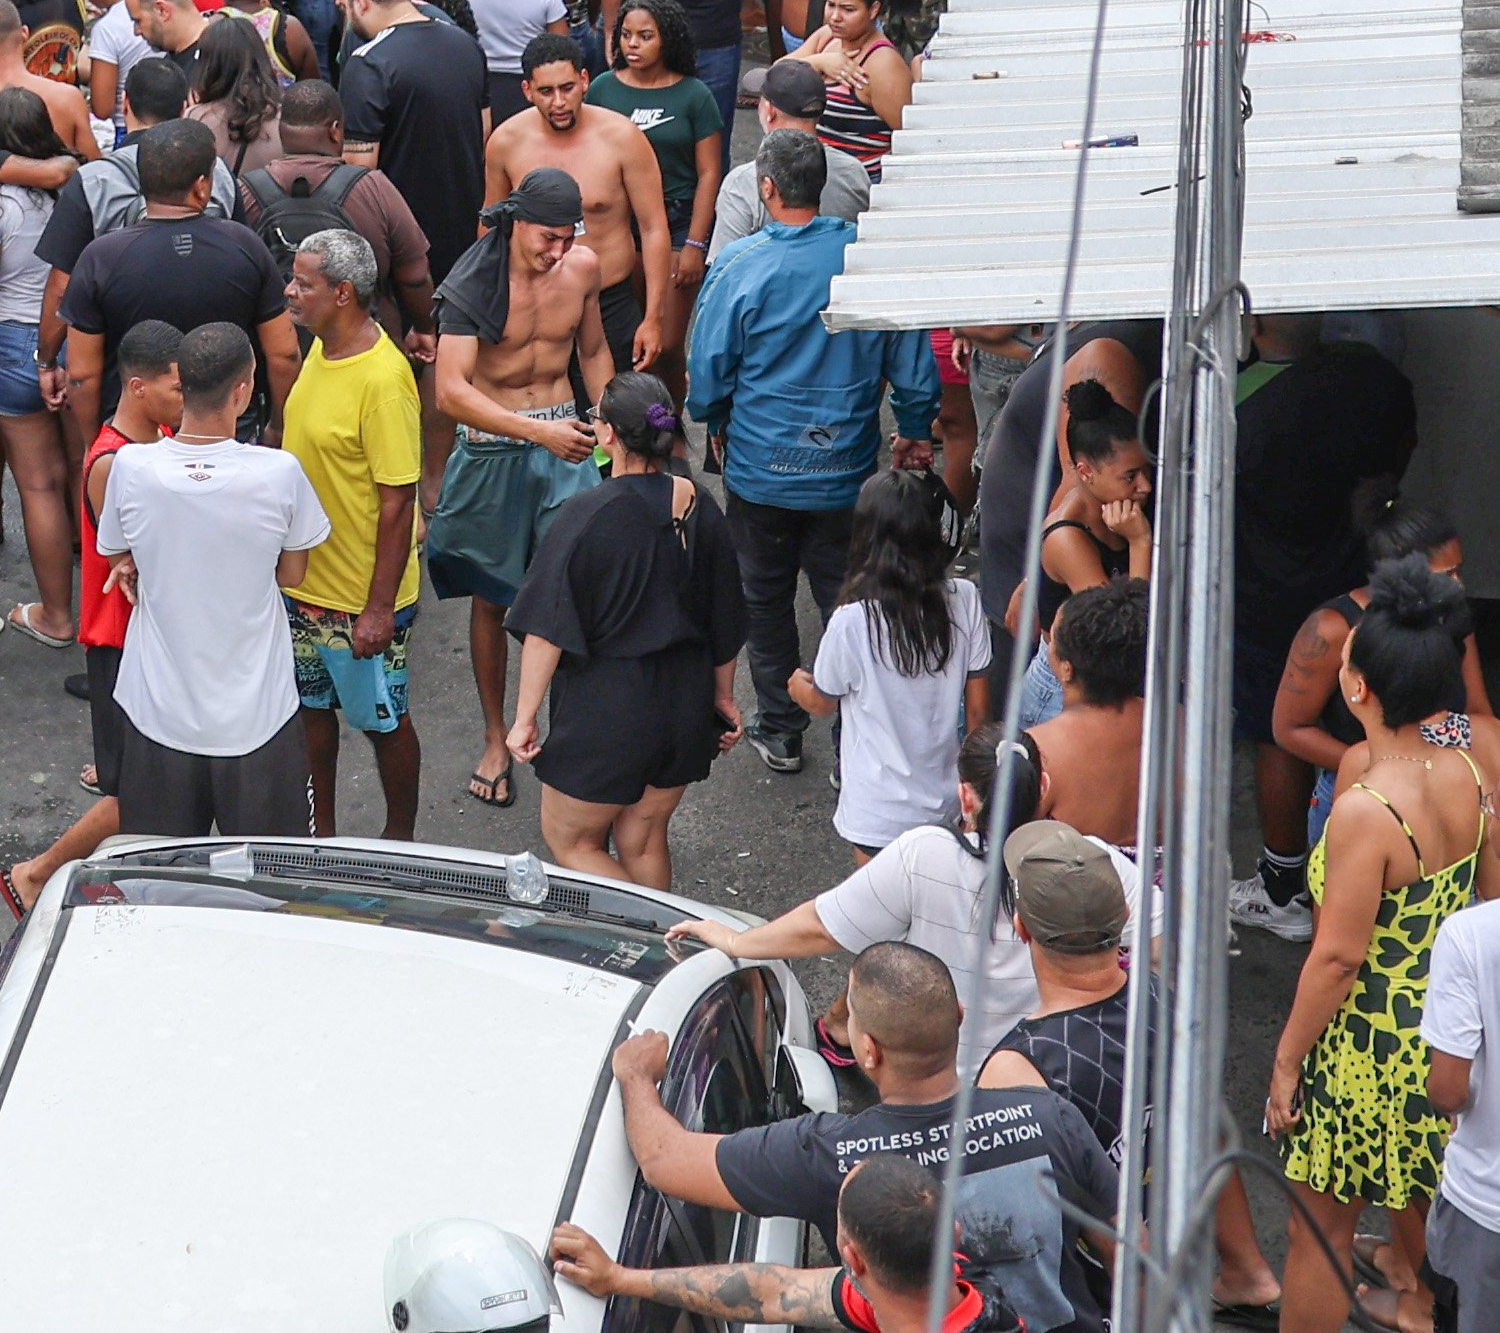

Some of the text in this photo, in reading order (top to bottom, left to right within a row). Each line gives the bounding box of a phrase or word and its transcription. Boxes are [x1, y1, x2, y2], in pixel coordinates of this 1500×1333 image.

[630, 109, 665, 124] NIKE
[1248, 902, 1269, 914] FILA
[836, 1104, 1033, 1157] SPOTLESS STRTPOINT
